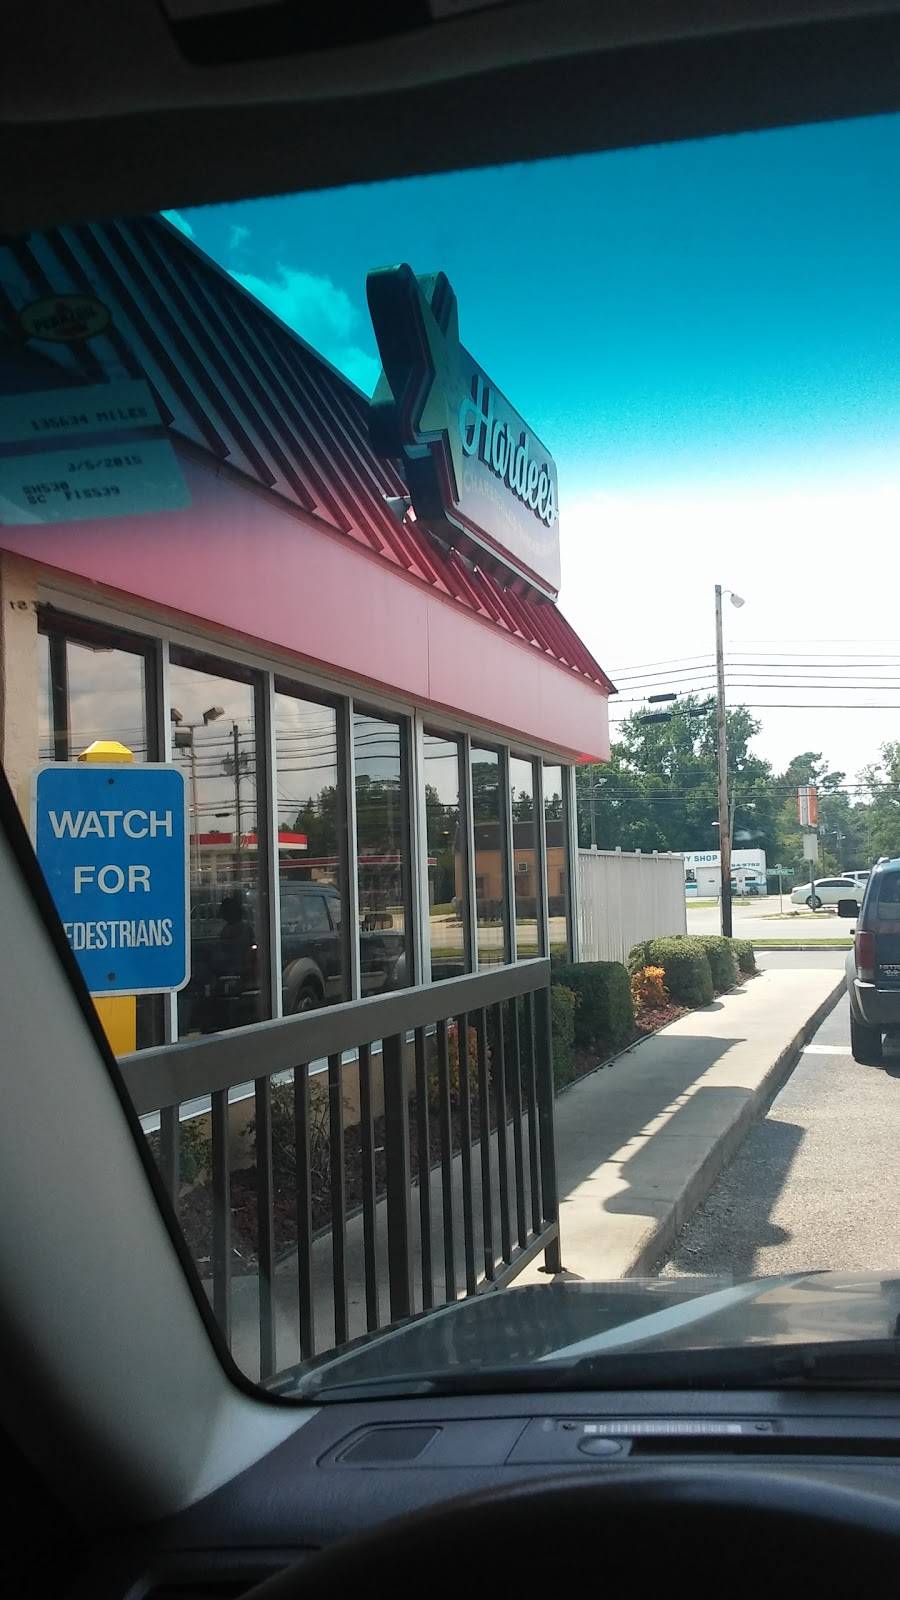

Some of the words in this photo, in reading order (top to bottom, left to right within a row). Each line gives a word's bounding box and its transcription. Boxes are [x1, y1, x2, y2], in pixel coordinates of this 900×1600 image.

[97, 407, 147, 422] MILES
[459, 374, 559, 528] Hardee's
[49, 809, 174, 839] WATCH
[73, 864, 151, 894] FOR
